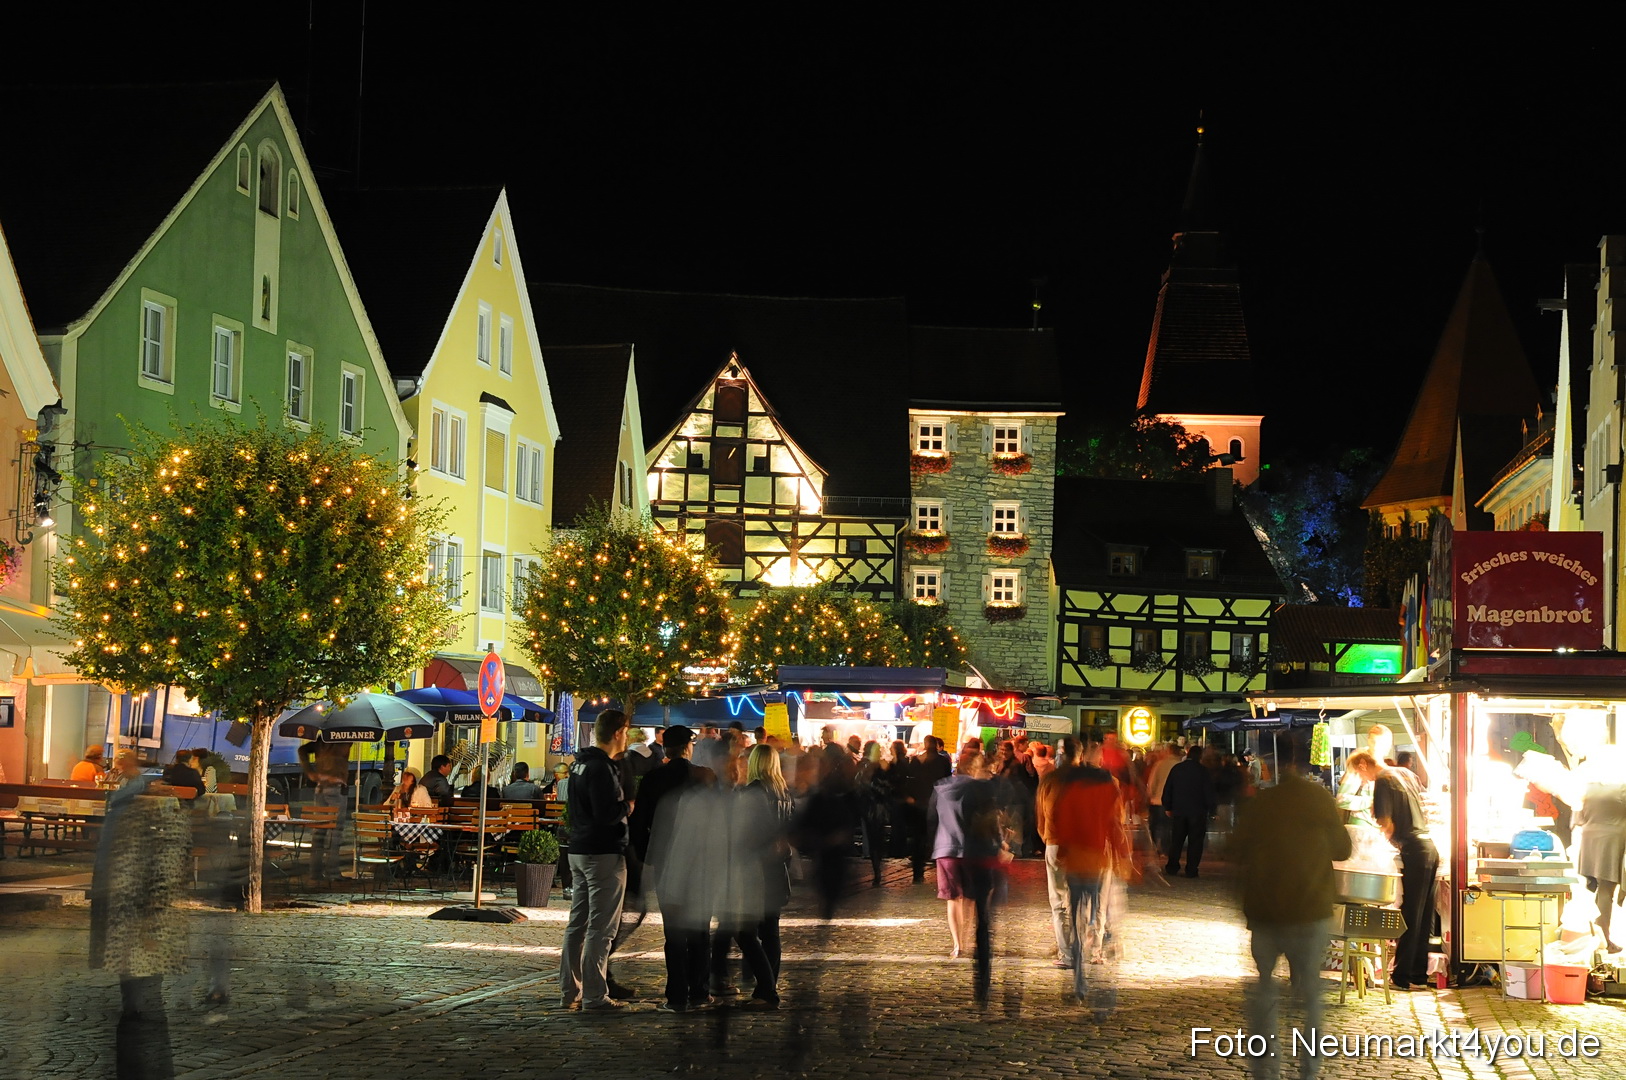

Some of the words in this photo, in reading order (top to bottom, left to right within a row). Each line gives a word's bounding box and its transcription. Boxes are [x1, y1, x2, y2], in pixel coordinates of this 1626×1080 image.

[1461, 550, 1528, 585] frisches
[1531, 550, 1598, 586] weiches
[1466, 605, 1593, 627] Magenbrot
[330, 731, 375, 740] PAULANER
